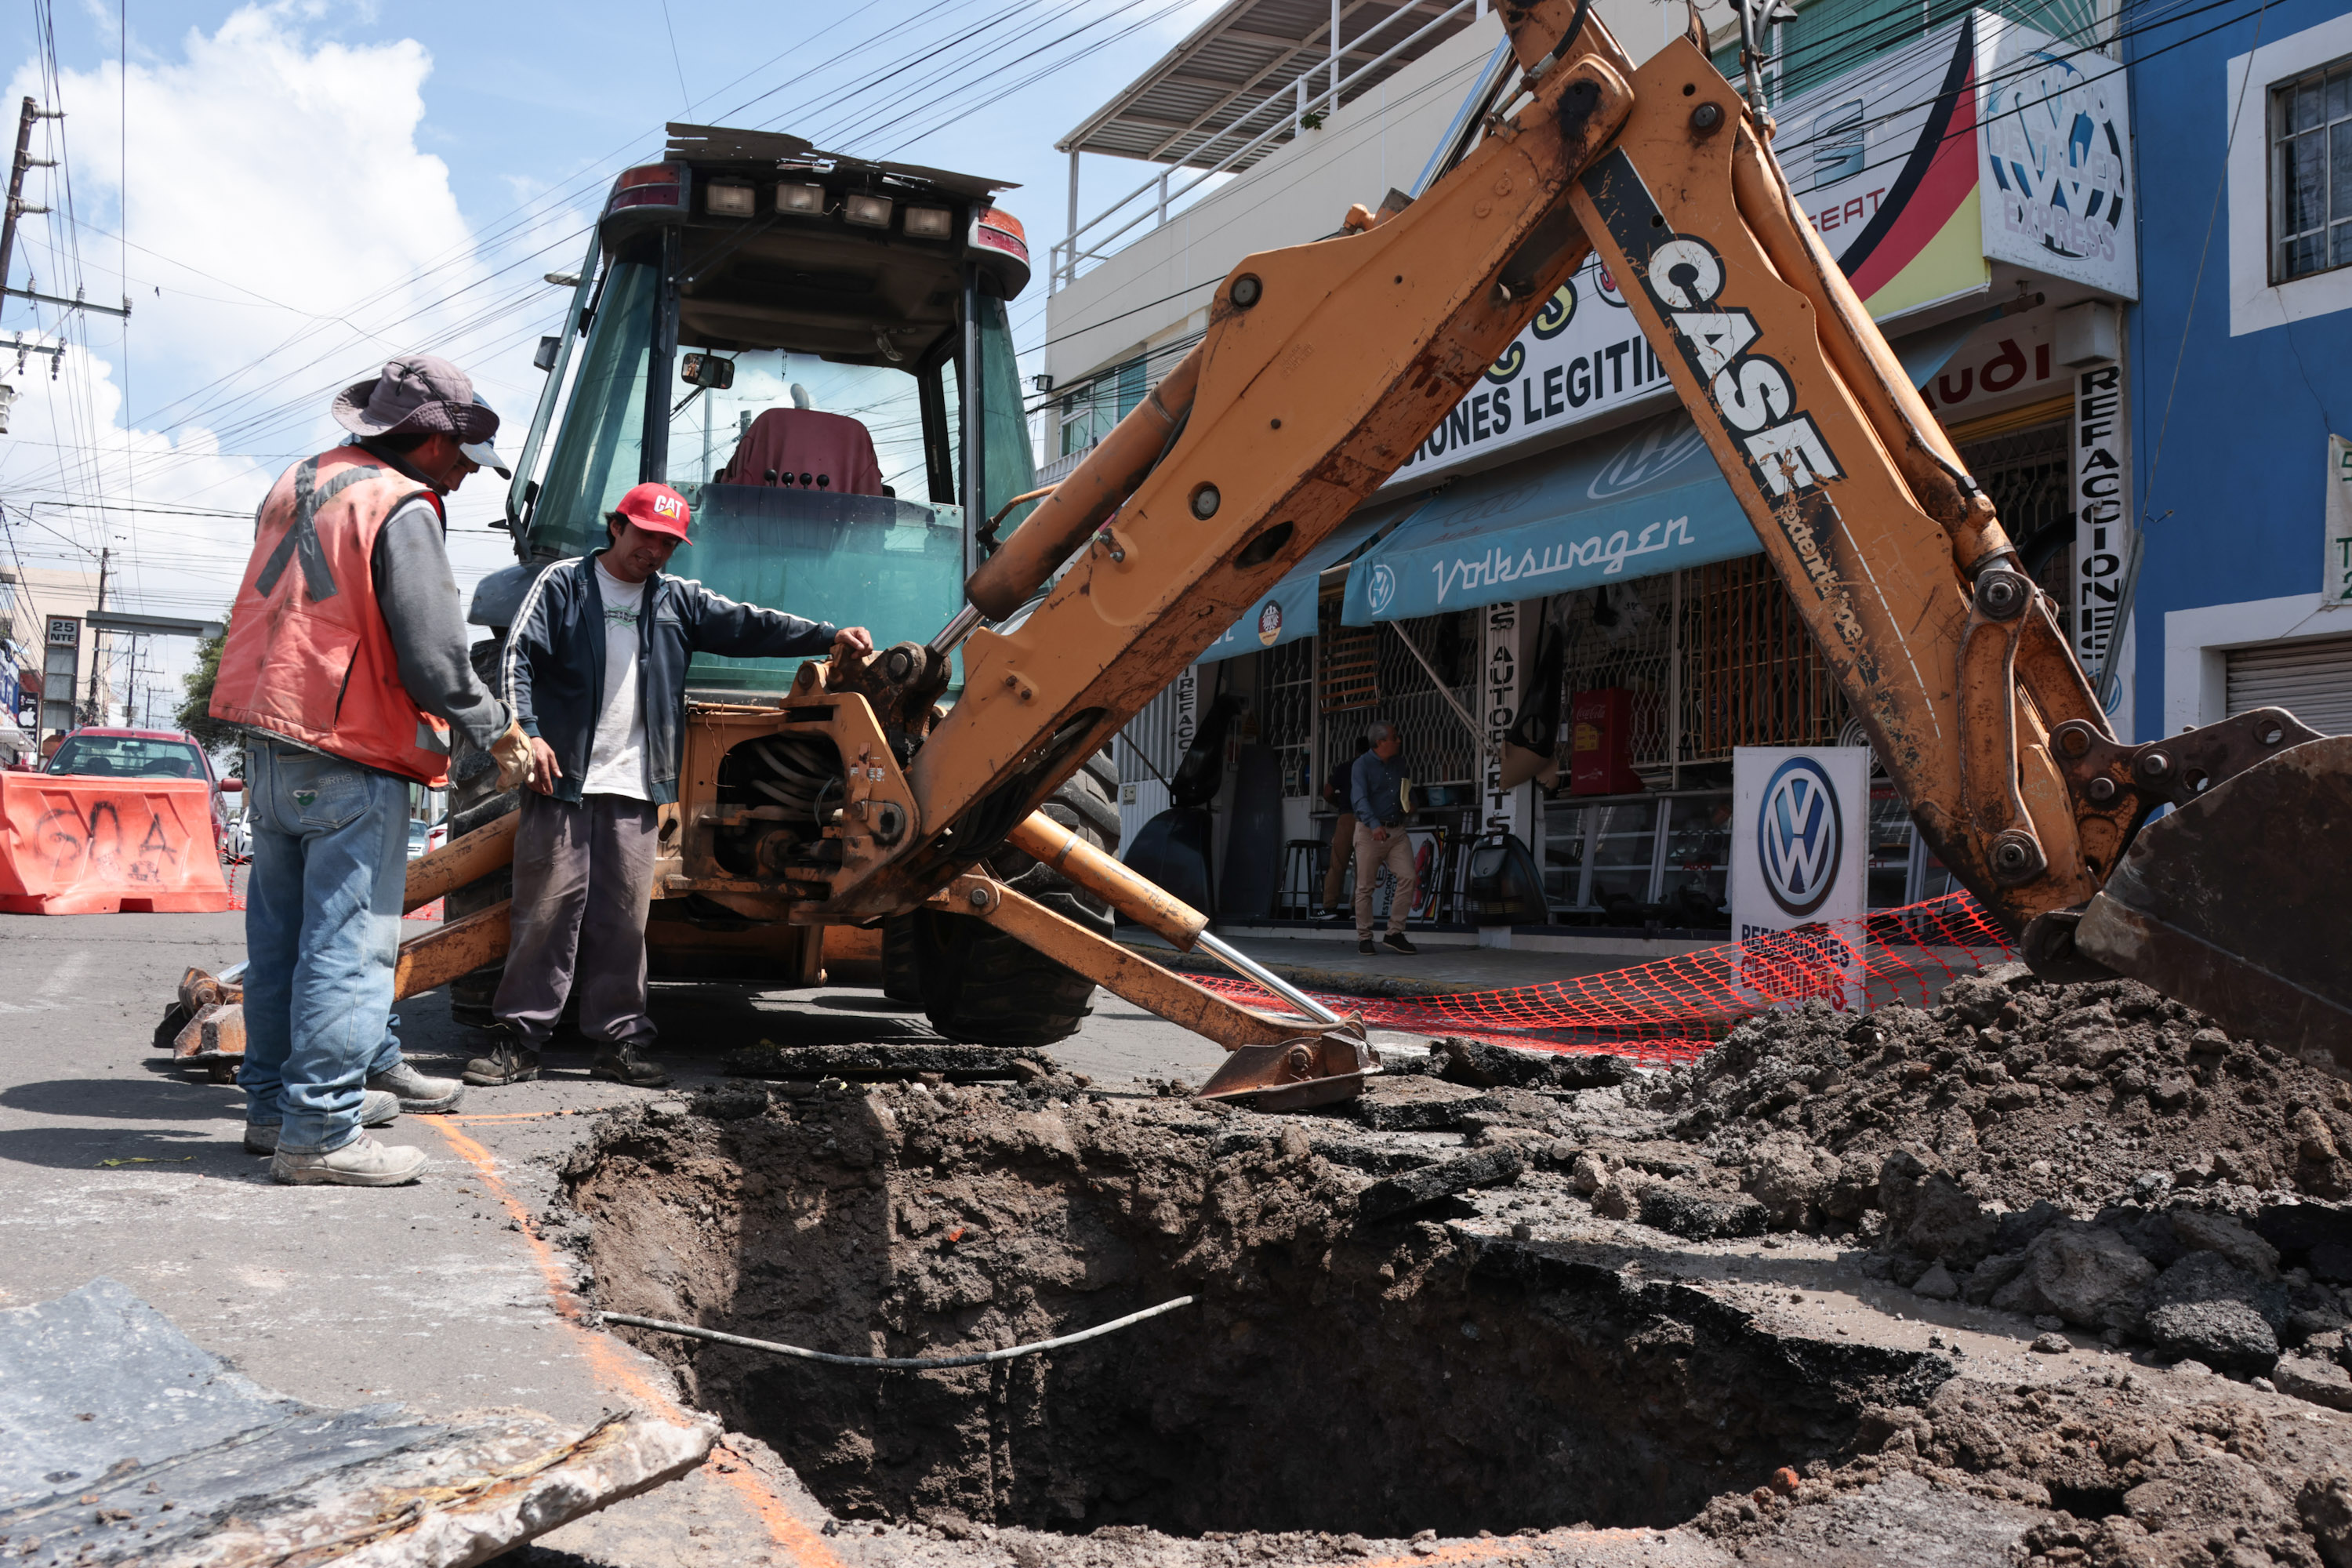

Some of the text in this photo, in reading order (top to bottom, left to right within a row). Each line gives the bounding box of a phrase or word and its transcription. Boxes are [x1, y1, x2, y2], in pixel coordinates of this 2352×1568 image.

[1990, 114, 2124, 197] DE TALLER
[2002, 192, 2116, 263] EXPRESS
[1649, 240, 1839, 496] CASE
[1402, 386, 1512, 468] IONES
[654, 495, 683, 521] CAT
[2081, 366, 2120, 660] REFACCIONES
[1432, 515, 1695, 604] Volkswagen
[50, 633, 75, 642] NTE
[52, 622, 74, 632] 25
[1178, 677, 1194, 759] REFACC
[318, 774, 353, 786] SIRHS
[1742, 924, 1849, 968] REFACCIONES
